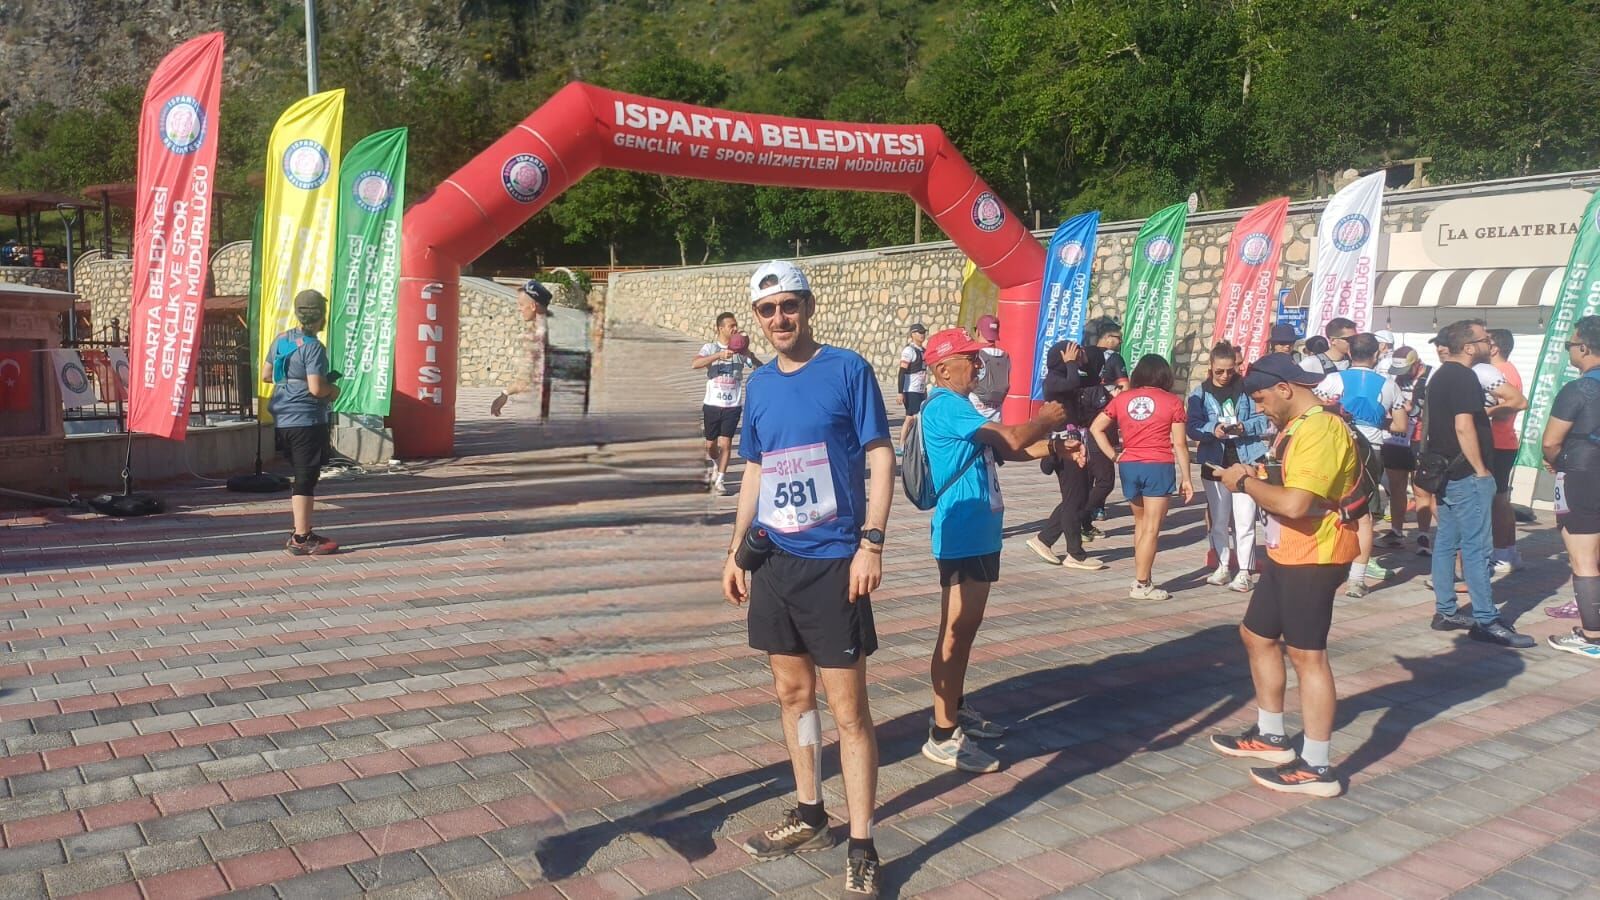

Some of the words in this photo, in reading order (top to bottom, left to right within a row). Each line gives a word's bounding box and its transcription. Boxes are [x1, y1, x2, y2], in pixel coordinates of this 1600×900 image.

[613, 132, 682, 155] GENÇLİK
[689, 143, 710, 159] VE
[715, 147, 755, 164] SPOR
[757, 150, 839, 171] HİZMETLERİ
[844, 157, 924, 174] MÜDÜRLÜĞÜ
[614, 100, 754, 144] ISPARTA
[760, 123, 925, 156] BELEDİYESİ
[149, 186, 169, 299] BELEDİYESİ
[172, 200, 189, 257] SPOR
[1474, 222, 1579, 239] GELATERIA
[169, 262, 183, 289] VE
[170, 301, 198, 417] HİZMETLERİ
[186, 165, 209, 297] MÜDÜRLÜĞÜ
[345, 234, 364, 316] BELEDİYESİ
[365, 244, 379, 285] SPOR
[379, 219, 397, 313] MÜDÜRLÜĞÜ
[364, 287, 377, 308] VE
[1045, 282, 1062, 337] BELEDİYESİ
[1061, 289, 1072, 316] SPOR
[1068, 272, 1086, 335] MÜDÜRLÜĞÜ
[1132, 281, 1149, 339] BELEDİYESİ
[1149, 288, 1160, 317] SPOR
[1158, 270, 1175, 337] MÜDÜRLÜĞÜ
[1224, 283, 1242, 340] ELEDİYESİ
[1241, 290, 1254, 321] SPOR
[1251, 270, 1271, 343] MÜDÜRLÜĞÜ
[1338, 279, 1352, 316] SPOR
[1352, 256, 1371, 333] ÜDÜRLÜĞÜ
[1544, 263, 1589, 365] BELEDİYESİ
[144, 306, 162, 389] ISPARTA
[161, 293, 180, 379] GENÇLİK
[343, 320, 357, 380] ISPARTA
[361, 311, 376, 373] GENÇLİK
[418, 282, 444, 404] FINISH
[1058, 318, 1069, 332] VE
[1146, 319, 1157, 333] VE
[1238, 323, 1249, 339] VE
[373, 316, 392, 400] HİZMETLERİ
[716, 391, 733, 401] 466
[774, 477, 818, 509] 581
